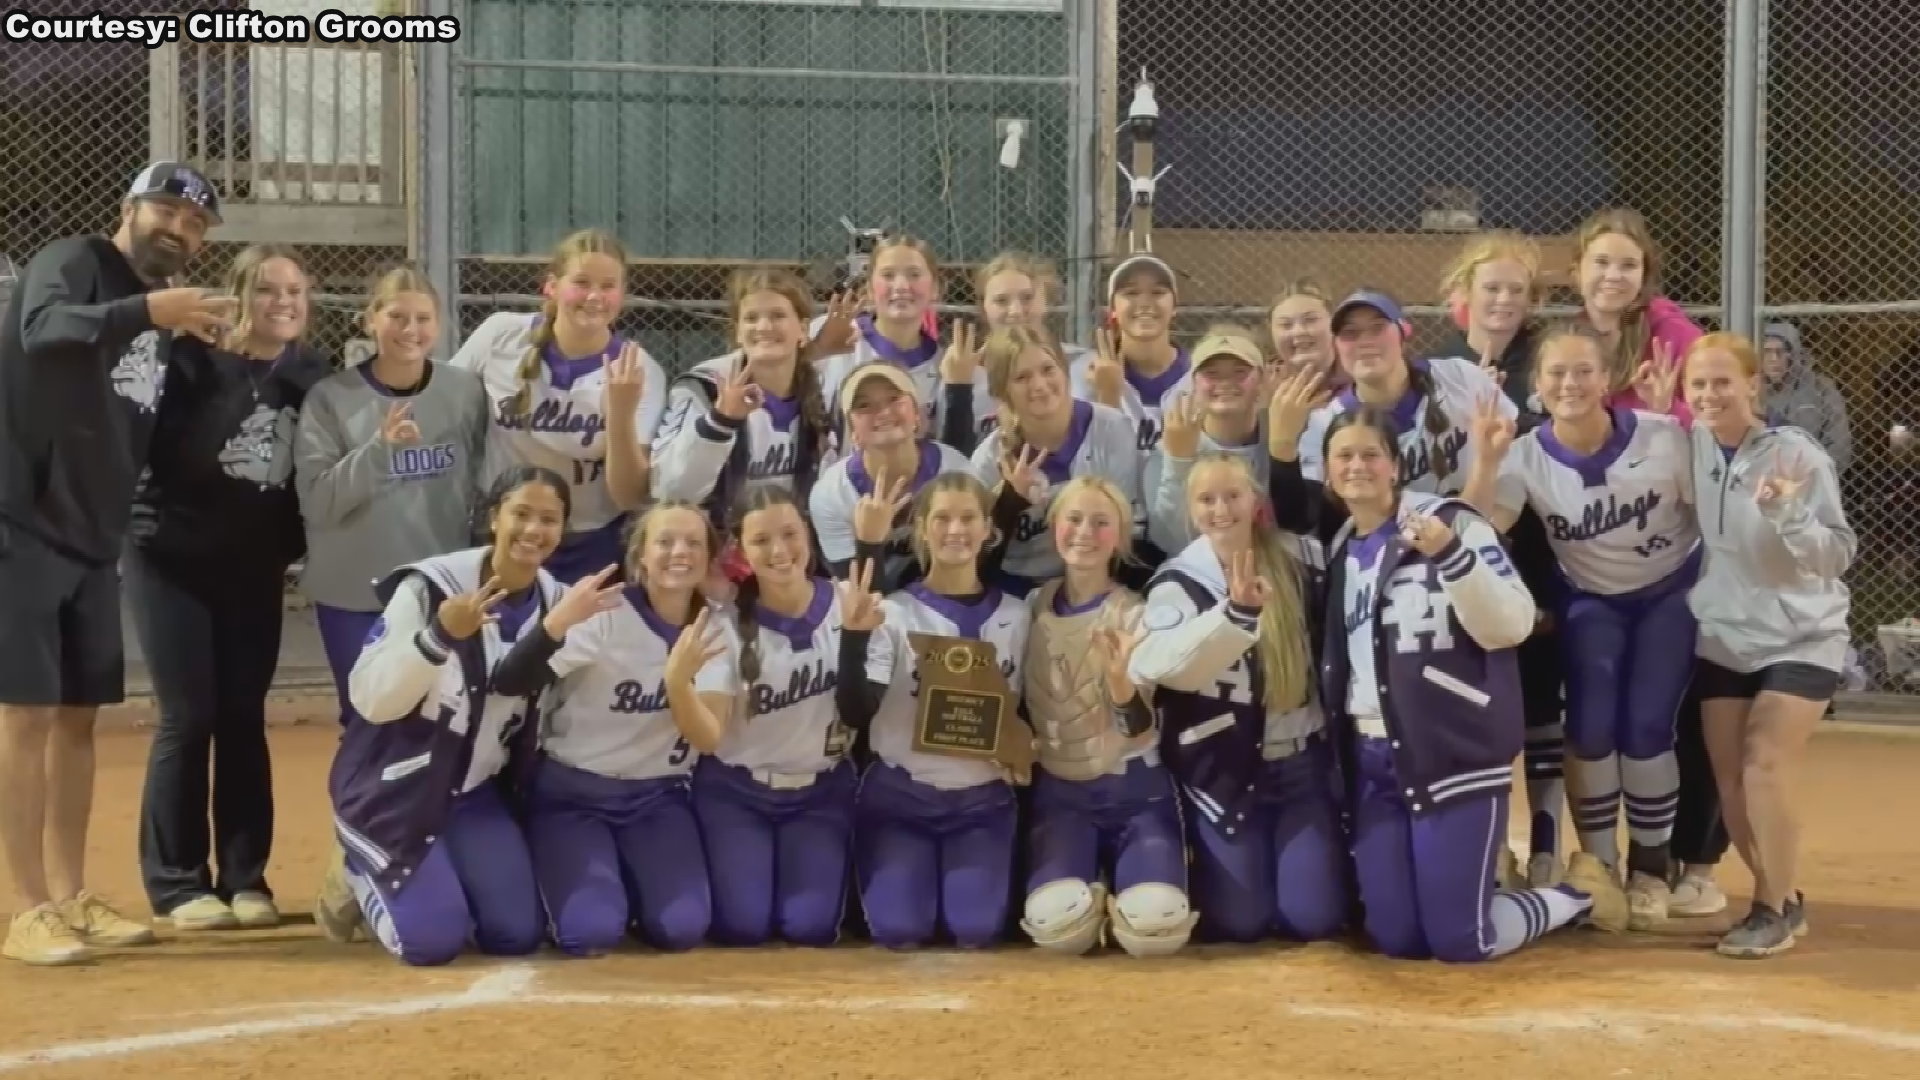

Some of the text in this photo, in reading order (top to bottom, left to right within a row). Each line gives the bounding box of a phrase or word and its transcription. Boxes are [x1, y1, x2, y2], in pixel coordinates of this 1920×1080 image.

[392, 444, 455, 475] LDOGS
[1547, 487, 1662, 541] Bulldogs
[751, 659, 840, 716] Bulldo
